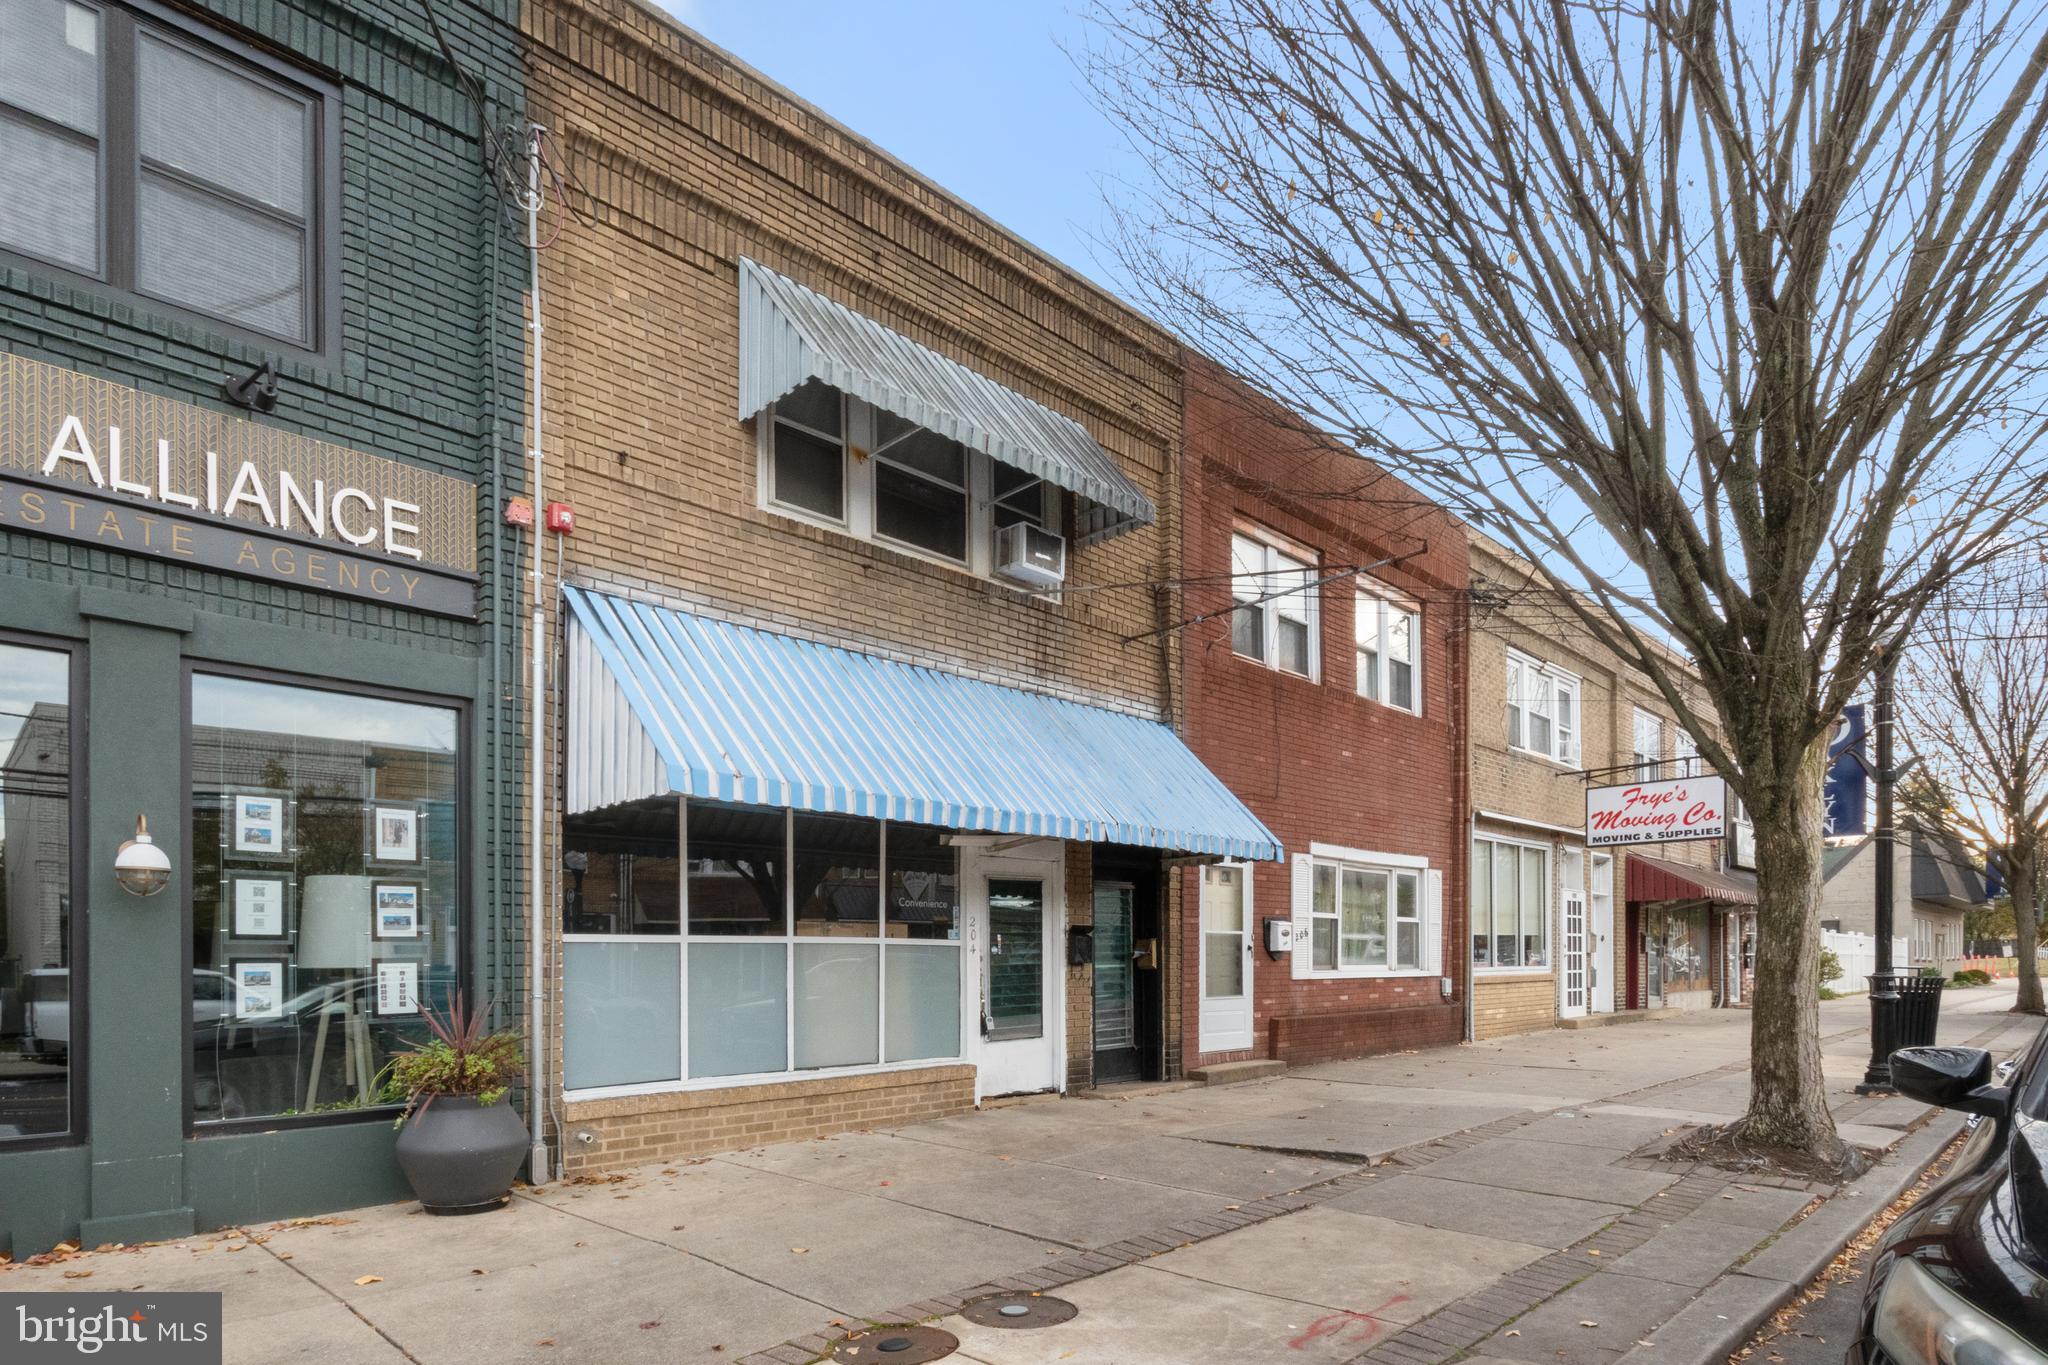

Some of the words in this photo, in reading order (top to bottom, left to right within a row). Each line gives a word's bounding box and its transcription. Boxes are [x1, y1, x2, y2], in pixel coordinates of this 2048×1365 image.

[42, 415, 421, 560] ALLIANCE
[0, 486, 195, 556] STATE
[236, 540, 420, 599] AGENCY
[1622, 785, 1688, 811] Frye's
[1590, 810, 1679, 831] Moving
[1683, 801, 1722, 825] Co.
[1592, 833, 1641, 844] MOVING
[1644, 831, 1653, 840] &
[1657, 826, 1722, 839] SUPPLIES
[898, 897, 948, 909] Convenience
[969, 916, 977, 954] 204
